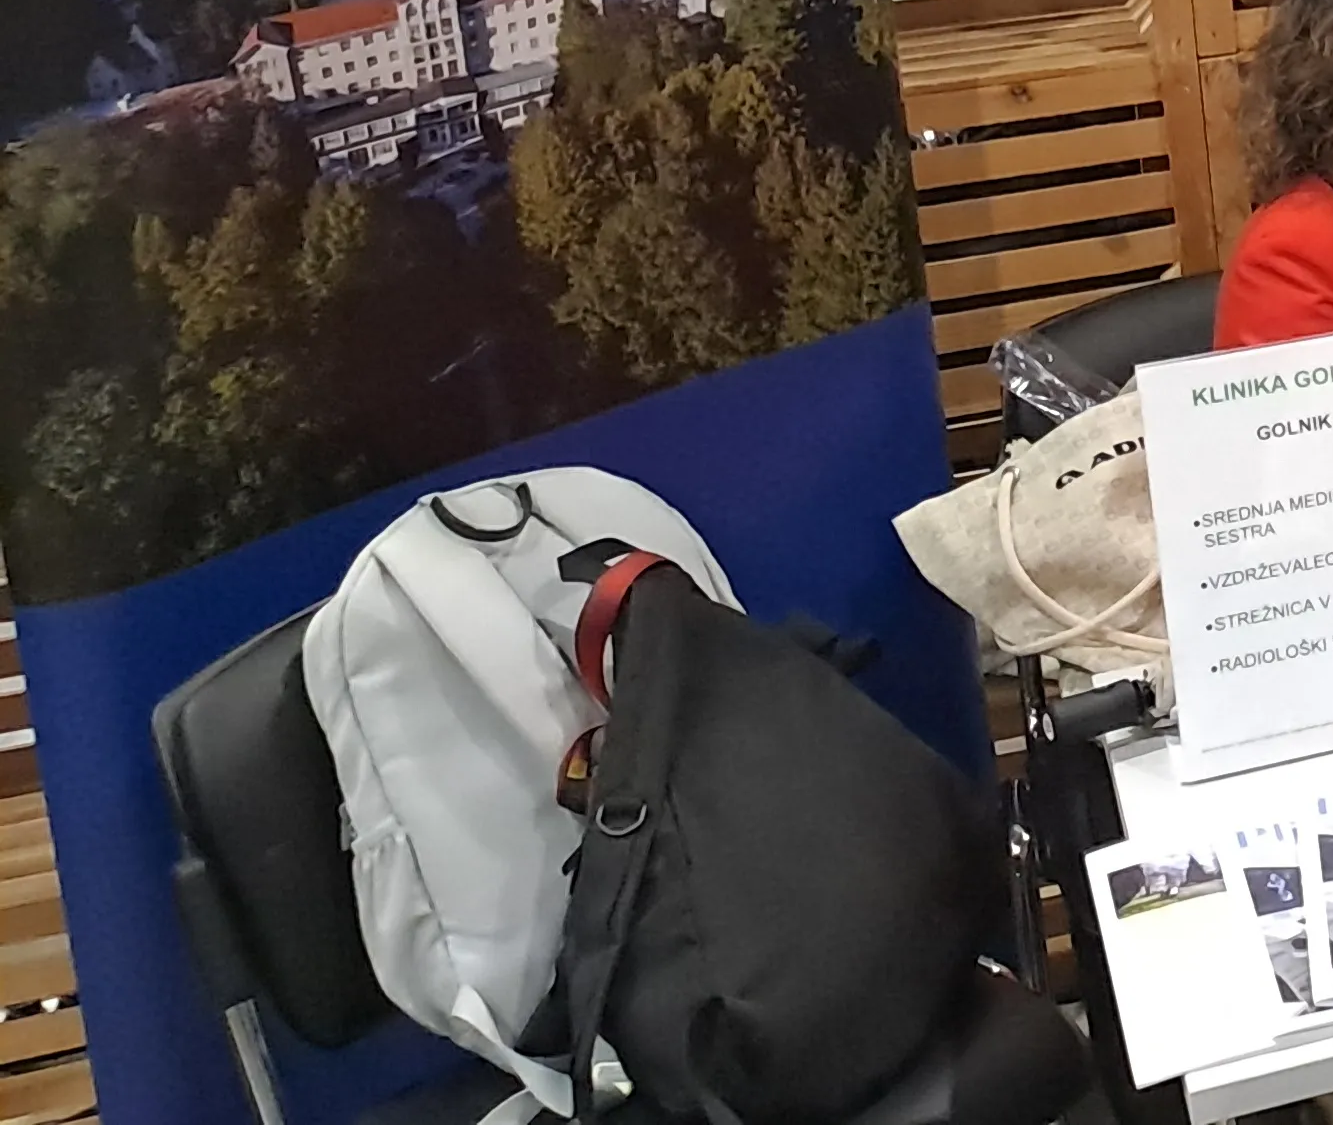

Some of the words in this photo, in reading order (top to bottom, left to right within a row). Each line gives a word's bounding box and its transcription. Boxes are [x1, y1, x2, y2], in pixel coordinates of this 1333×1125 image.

[1191, 375, 1288, 407] KLINIKA
[1256, 413, 1333, 441] GOLNIK
[1202, 499, 1285, 528] SREDNJA
[1204, 522, 1277, 548] SESTRA
[1214, 599, 1315, 632] STREŽNICA
[1319, 594, 1332, 610] V
[1219, 638, 1327, 673] RADIOLOŠKI
